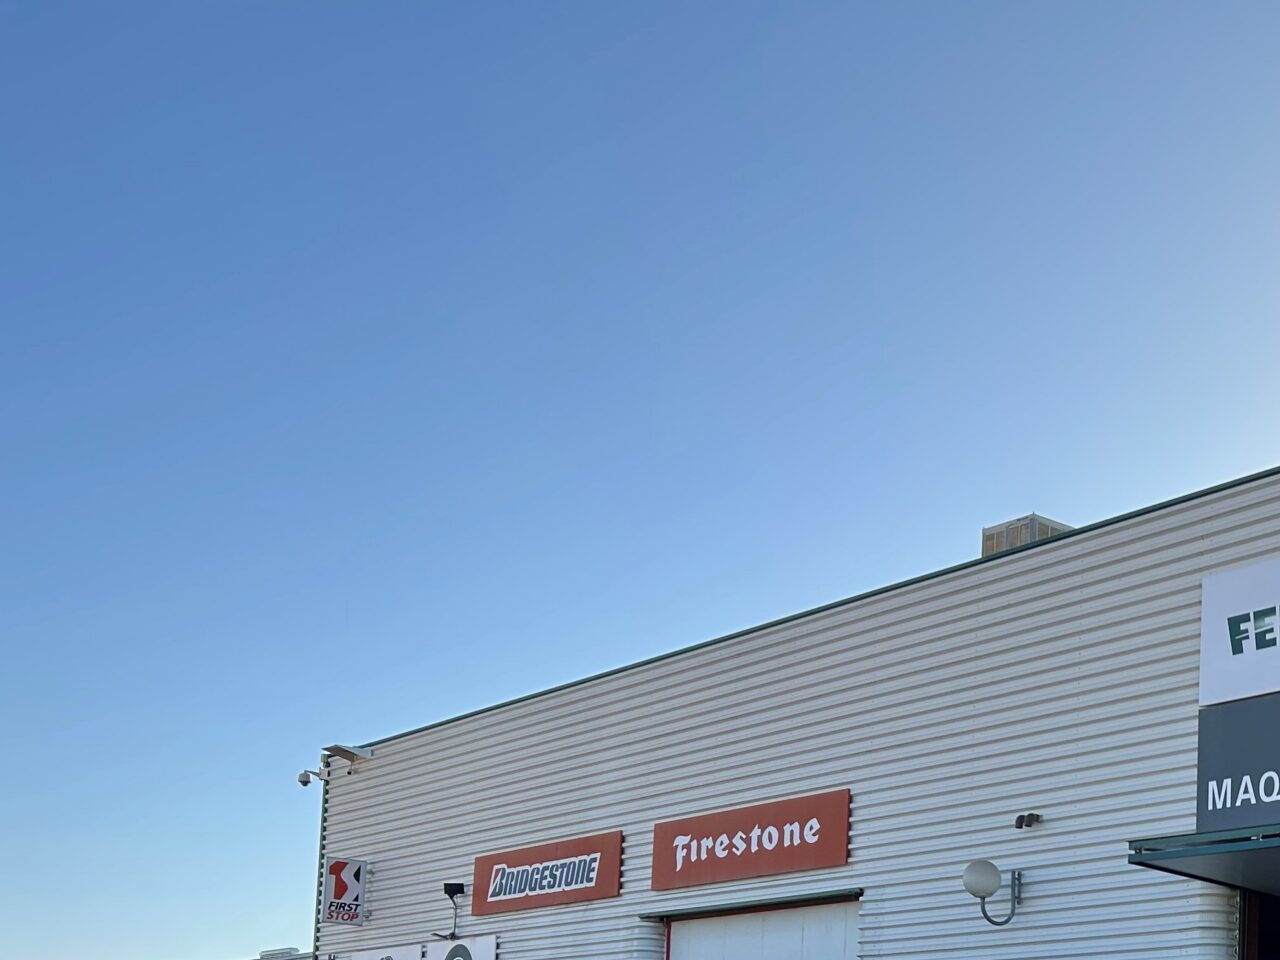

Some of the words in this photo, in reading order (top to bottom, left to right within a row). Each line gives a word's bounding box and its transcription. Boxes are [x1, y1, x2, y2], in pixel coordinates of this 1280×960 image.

[673, 816, 821, 872] Firestone
[488, 853, 600, 901] BRIDGESTONE
[326, 911, 359, 922] STOP
[328, 901, 361, 912] FIRST
